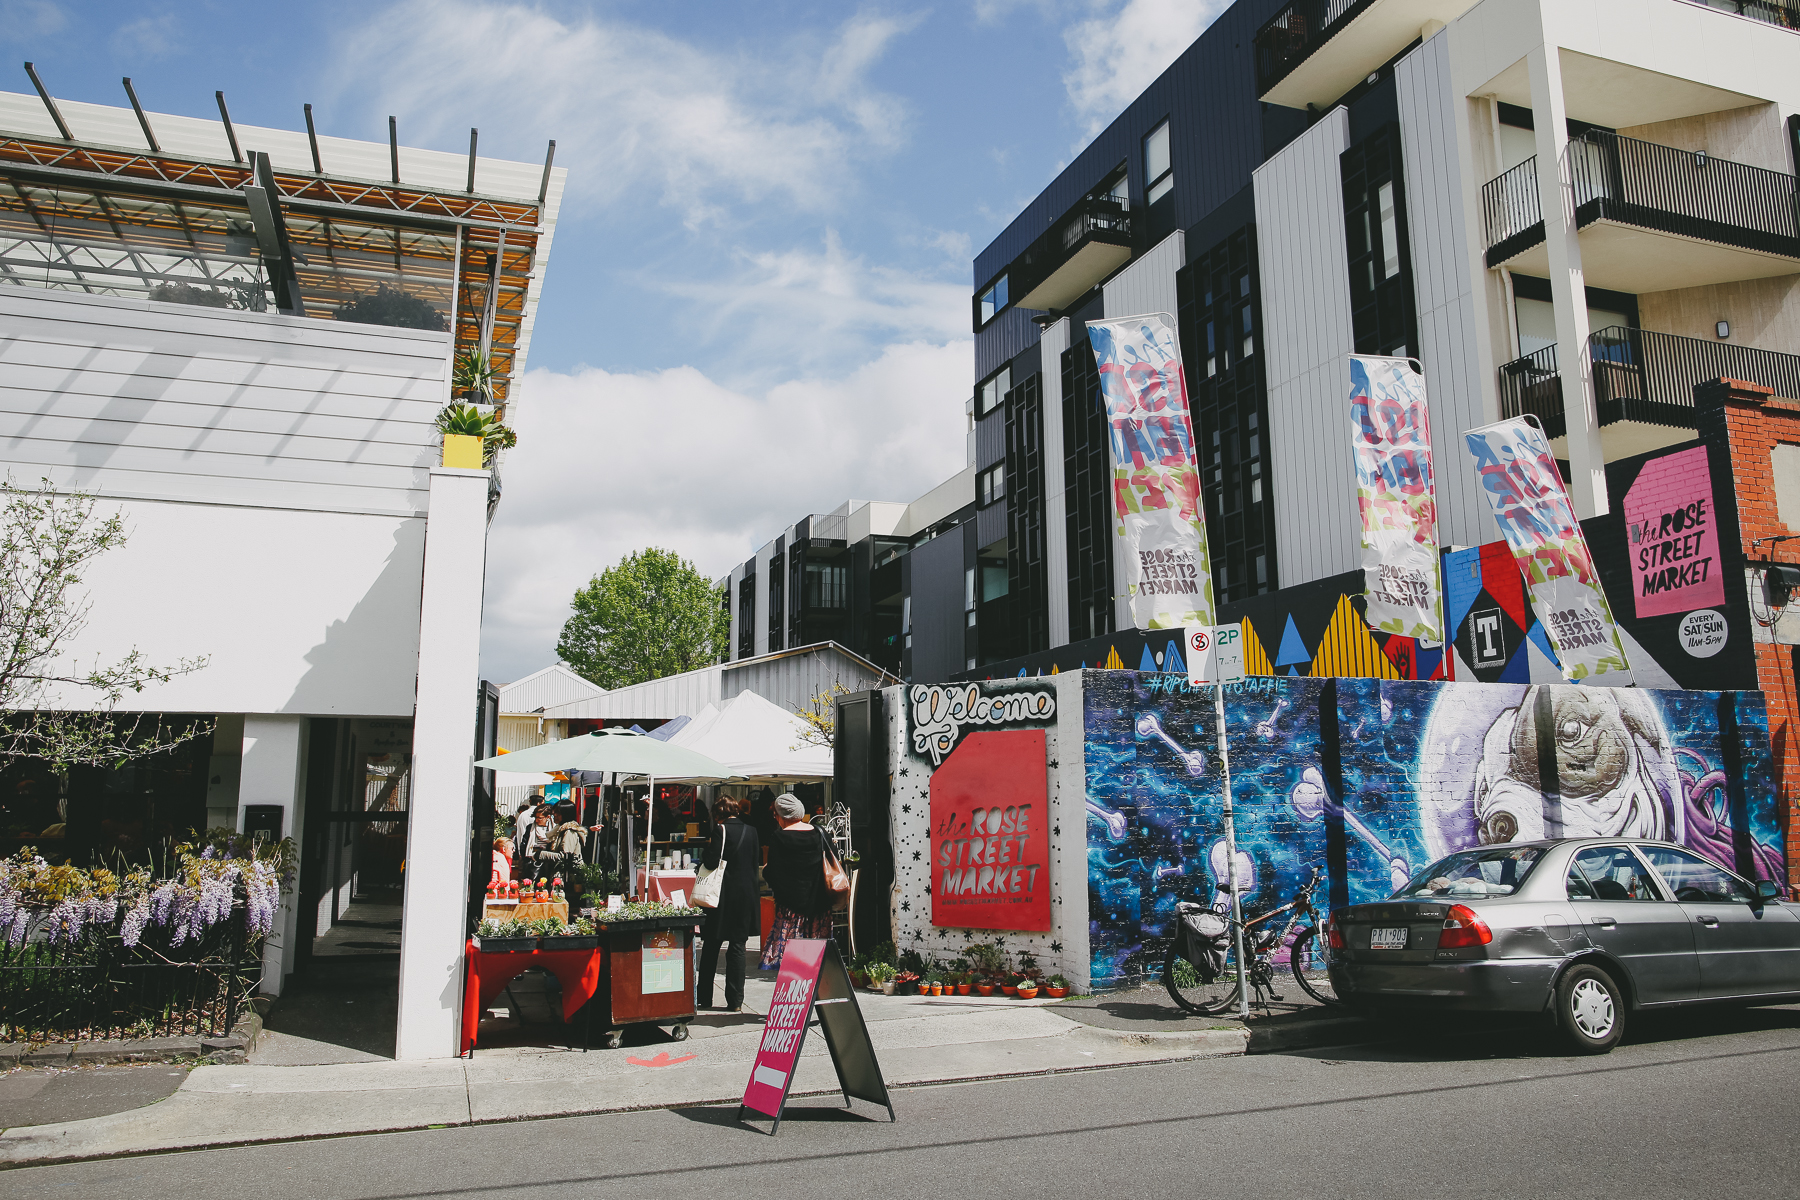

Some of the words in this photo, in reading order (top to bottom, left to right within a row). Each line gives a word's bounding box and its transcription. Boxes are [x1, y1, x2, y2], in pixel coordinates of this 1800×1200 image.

[1639, 520, 1660, 545] the
[1658, 499, 1706, 540] ROSE
[1638, 530, 1706, 571] STREET
[1642, 557, 1712, 598] MARKET
[1683, 620, 1724, 636] SAT/SUN
[1689, 613, 1715, 624] EVERY
[1217, 629, 1239, 646] 2P
[913, 683, 1055, 728] Welcome
[370, 722, 413, 730] COURTYAR
[915, 723, 957, 766] To
[936, 812, 969, 837] the
[970, 803, 1032, 836] ROSE
[937, 834, 1031, 867] STREET
[939, 863, 1041, 896] MARKET
[774, 983, 787, 1002] the
[786, 979, 812, 1002] ROSE
[768, 1004, 804, 1027] STREET
[761, 1029, 800, 1053] MARKET
